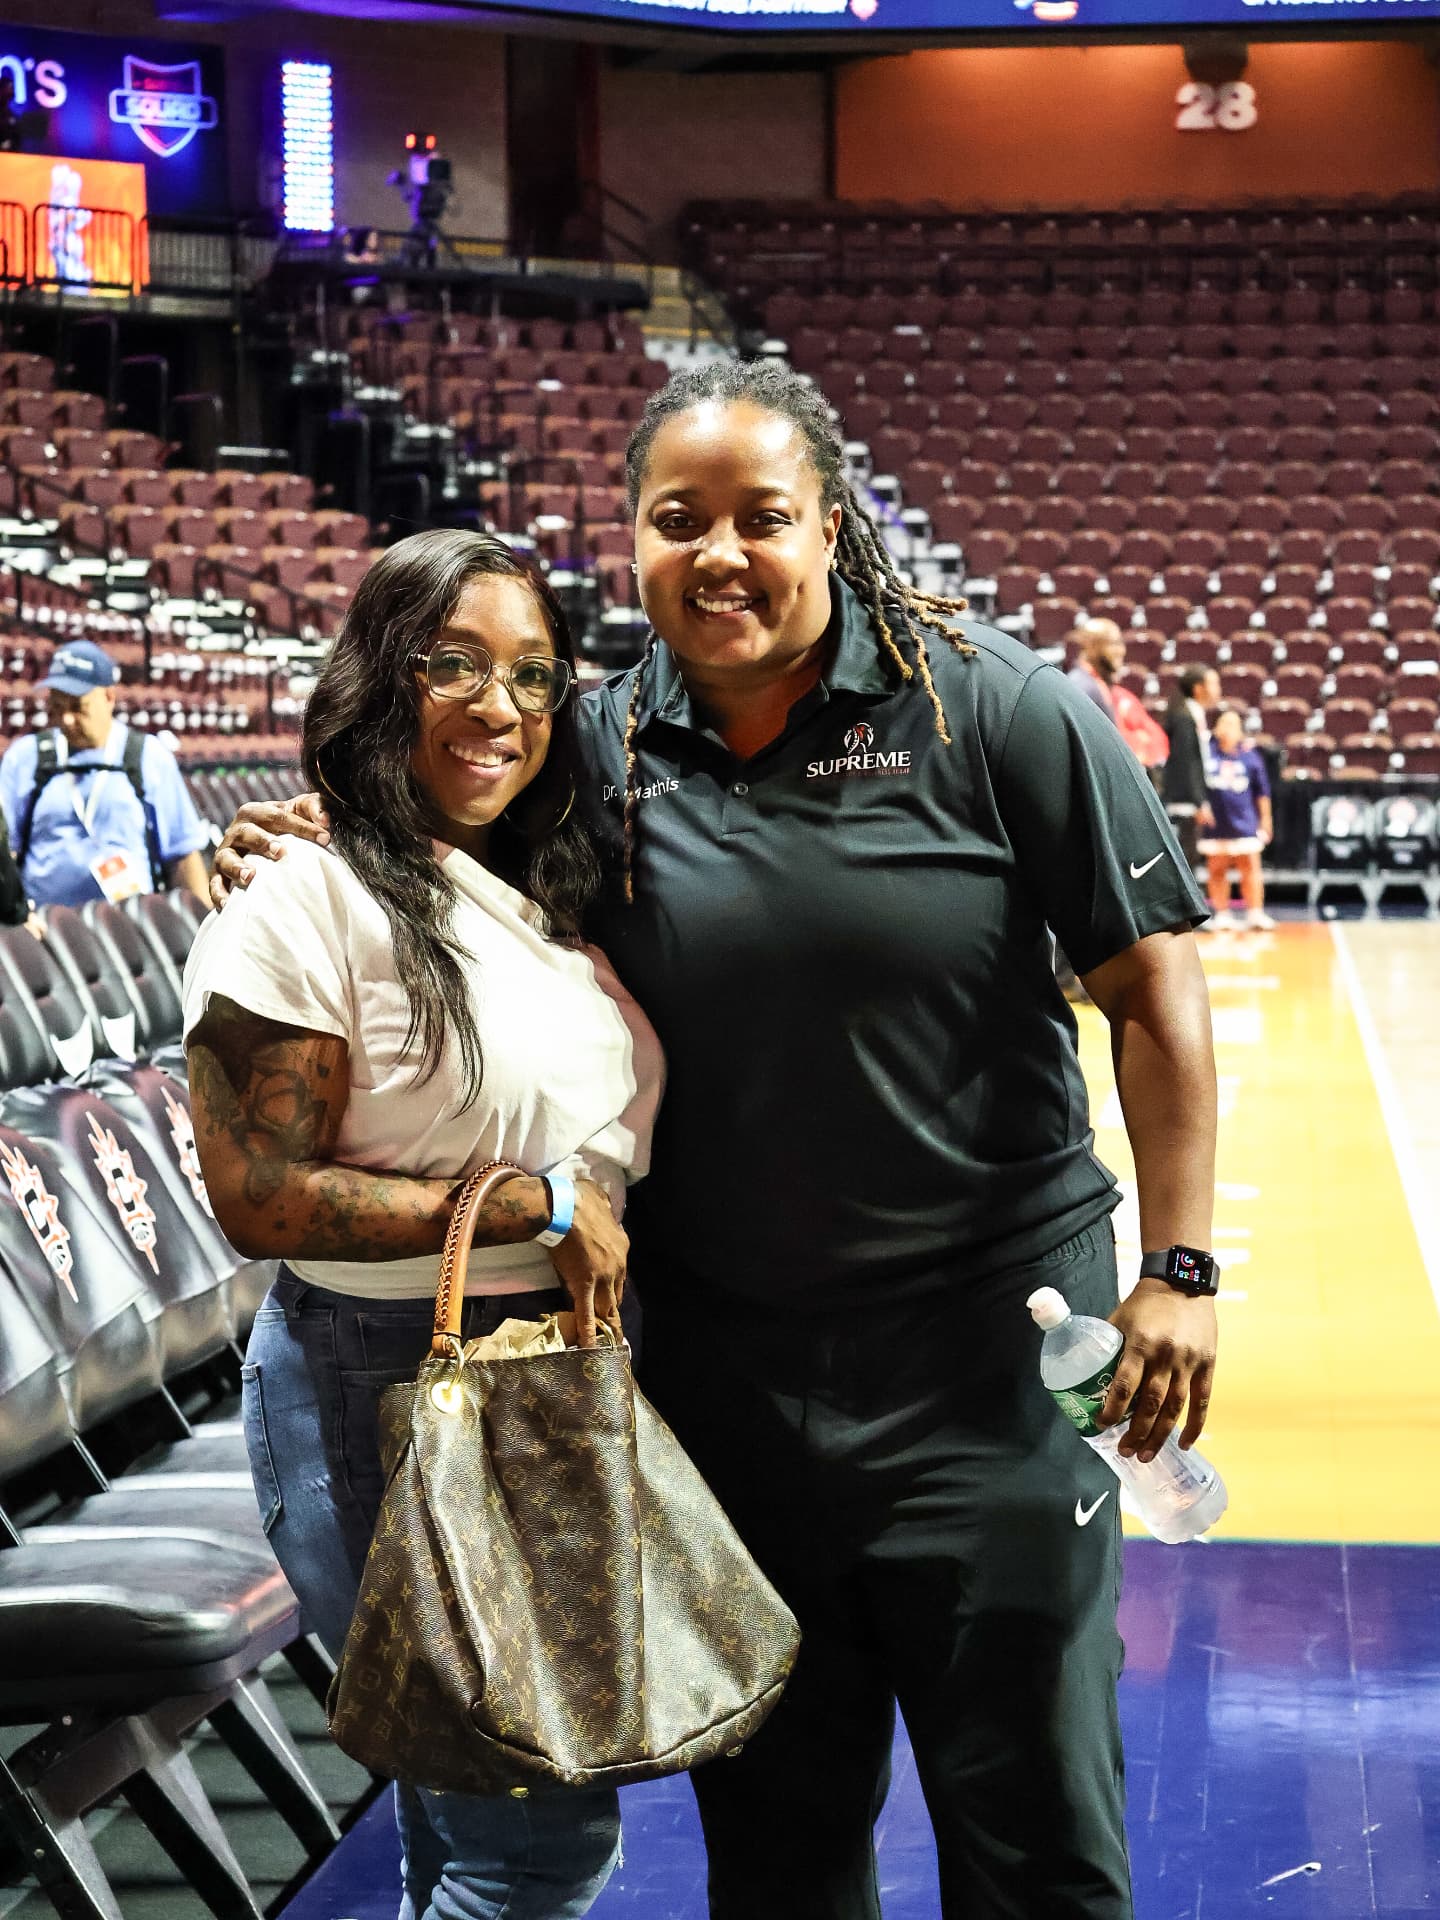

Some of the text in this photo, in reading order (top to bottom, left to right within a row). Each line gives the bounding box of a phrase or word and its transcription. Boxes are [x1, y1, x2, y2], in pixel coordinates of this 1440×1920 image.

[1176, 82, 1258, 131] 28
[806, 750, 911, 778] SUPREME
[603, 784, 618, 802] Dr.
